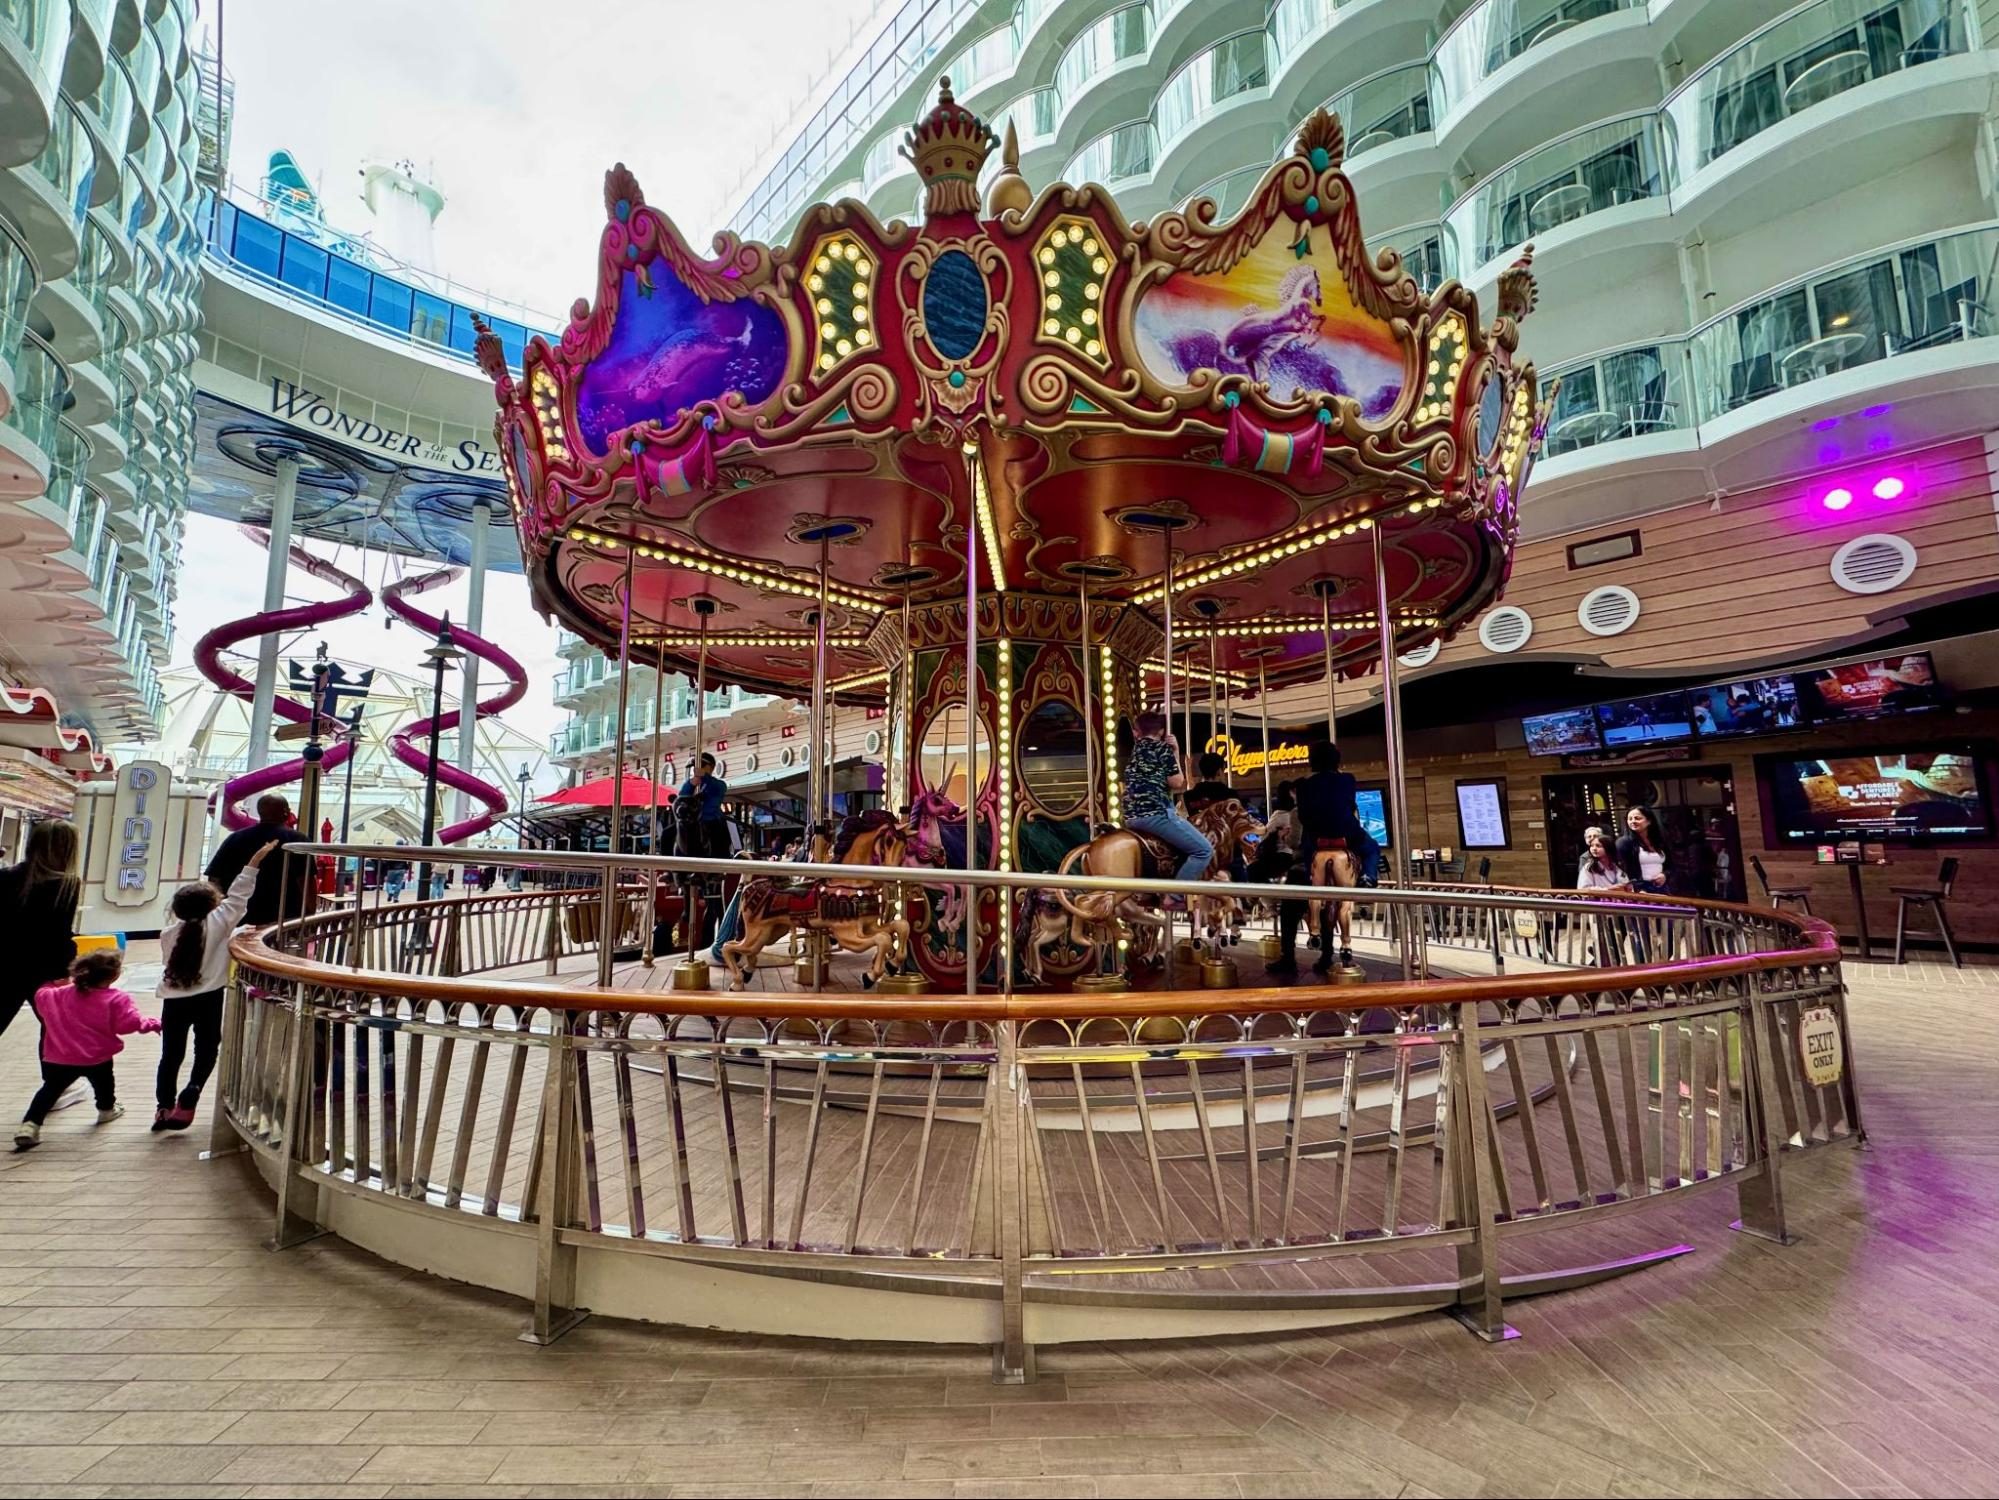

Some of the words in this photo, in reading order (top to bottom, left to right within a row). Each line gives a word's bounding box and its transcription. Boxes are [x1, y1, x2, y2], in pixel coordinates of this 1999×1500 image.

[272, 376, 422, 459] WONDER
[423, 450, 448, 463] THE
[431, 444, 447, 453] OF
[452, 441, 504, 472] SE
[1807, 1031, 1834, 1054] EXIT
[1813, 1054, 1833, 1068] ONLY
